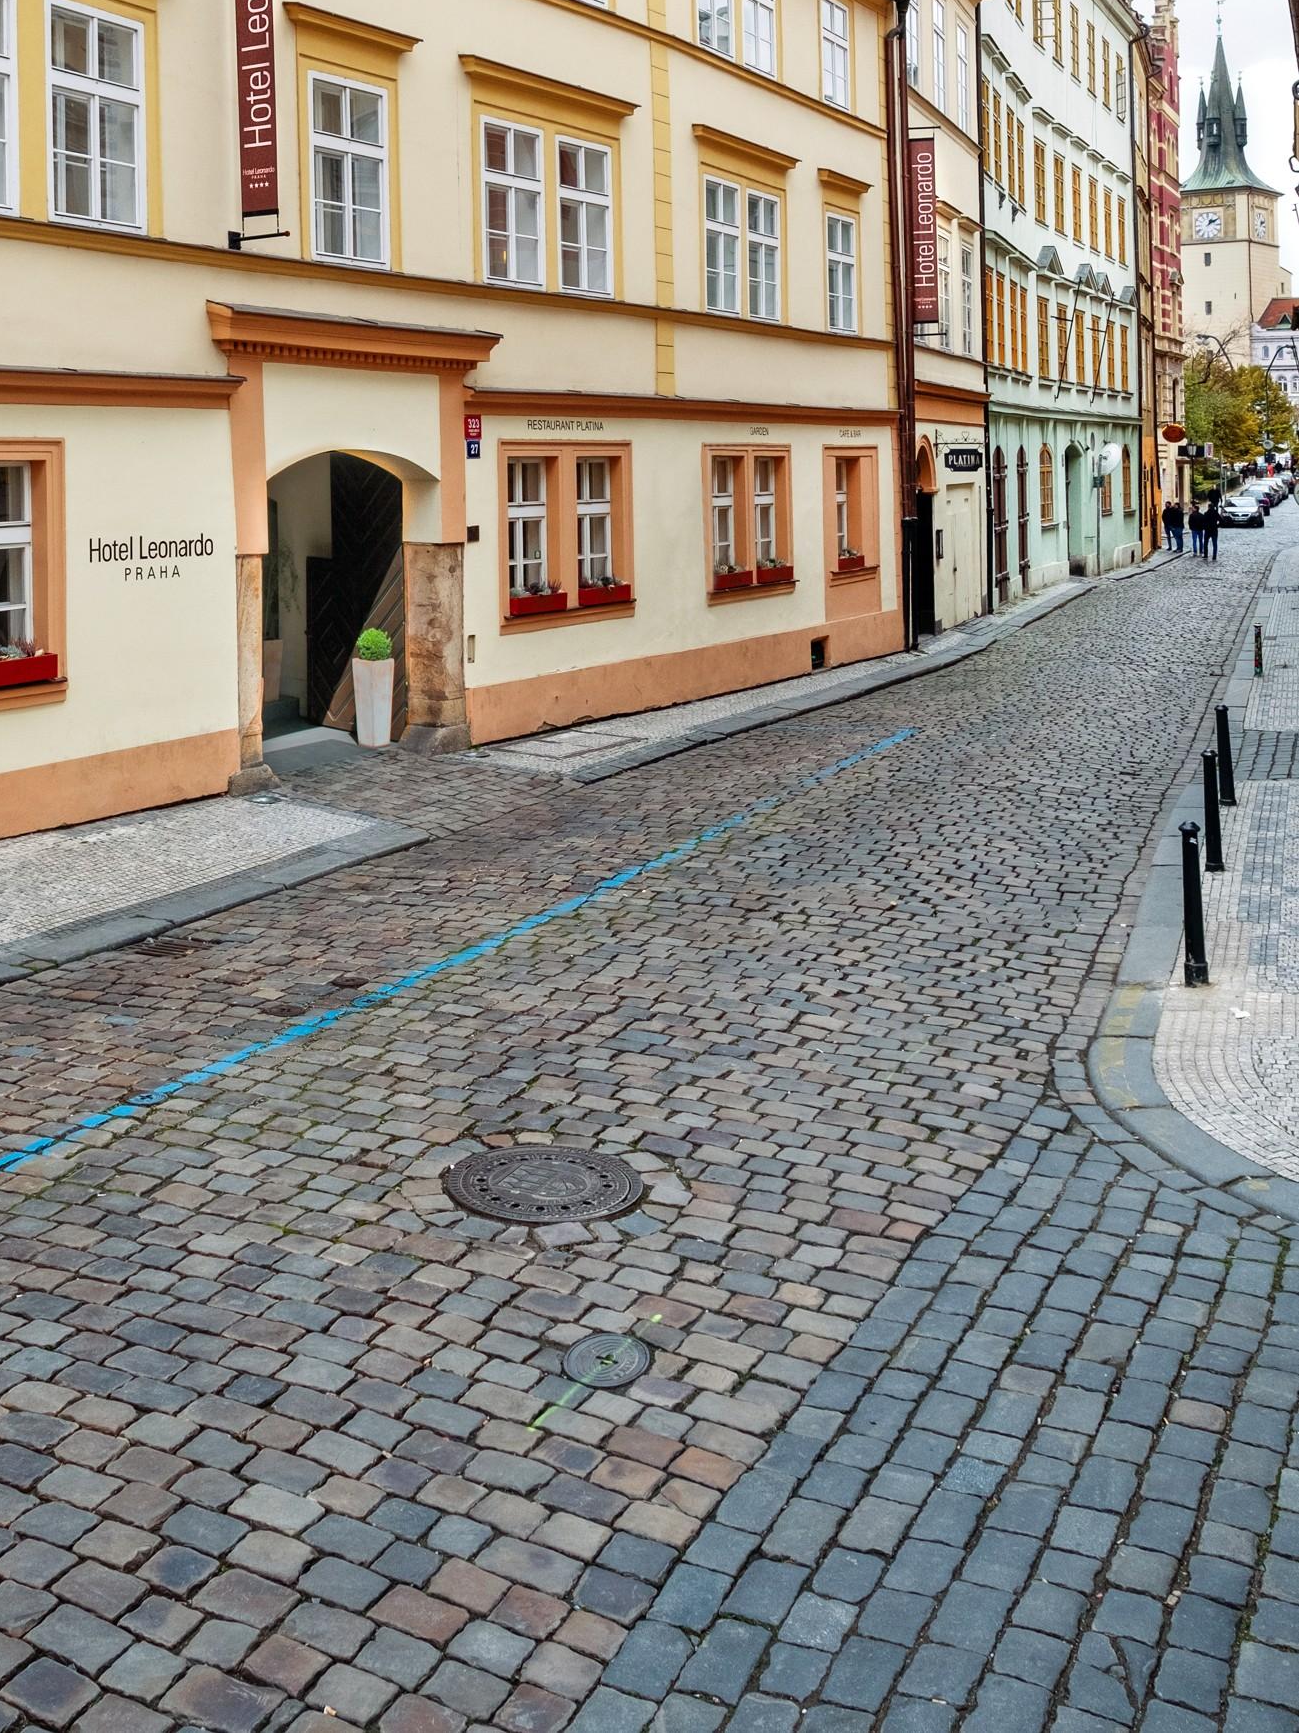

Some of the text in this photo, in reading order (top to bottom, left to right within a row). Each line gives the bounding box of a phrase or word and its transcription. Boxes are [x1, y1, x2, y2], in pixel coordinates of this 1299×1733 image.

[241, 61, 272, 149] Hotel
[912, 152, 934, 235] Leonardo
[914, 240, 935, 287] Hotel
[467, 418, 480, 428] 323
[527, 419, 604, 431] RESTAURANT PLATINA
[750, 426, 769, 435] GARDEN
[471, 444, 478, 454] 27
[89, 533, 214, 563] Hotel Leonardo
[124, 565, 180, 581] PRAHA
